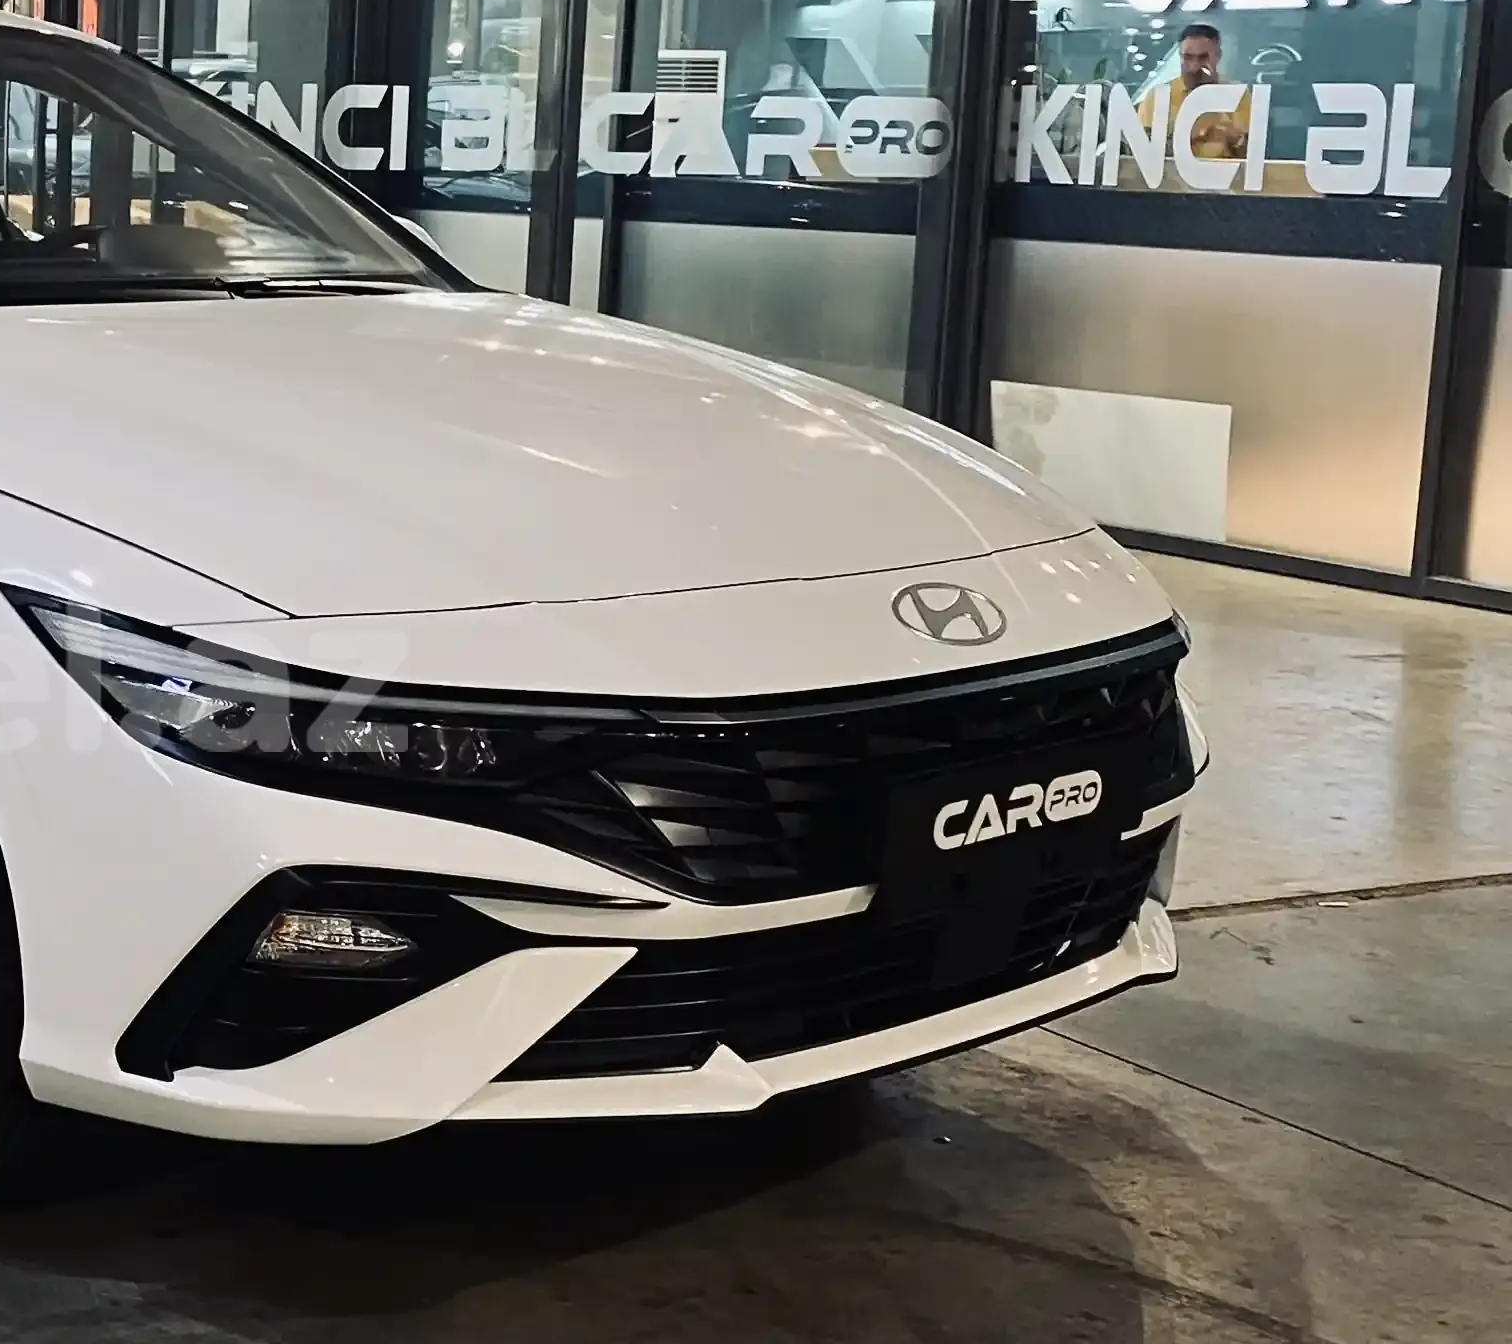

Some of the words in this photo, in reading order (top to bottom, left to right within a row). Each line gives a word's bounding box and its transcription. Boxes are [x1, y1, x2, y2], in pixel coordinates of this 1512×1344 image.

[577, 93, 824, 178] CAR
[845, 119, 950, 156] PRO
[933, 783, 1044, 850] CAR
[1049, 781, 1098, 812] PRO
